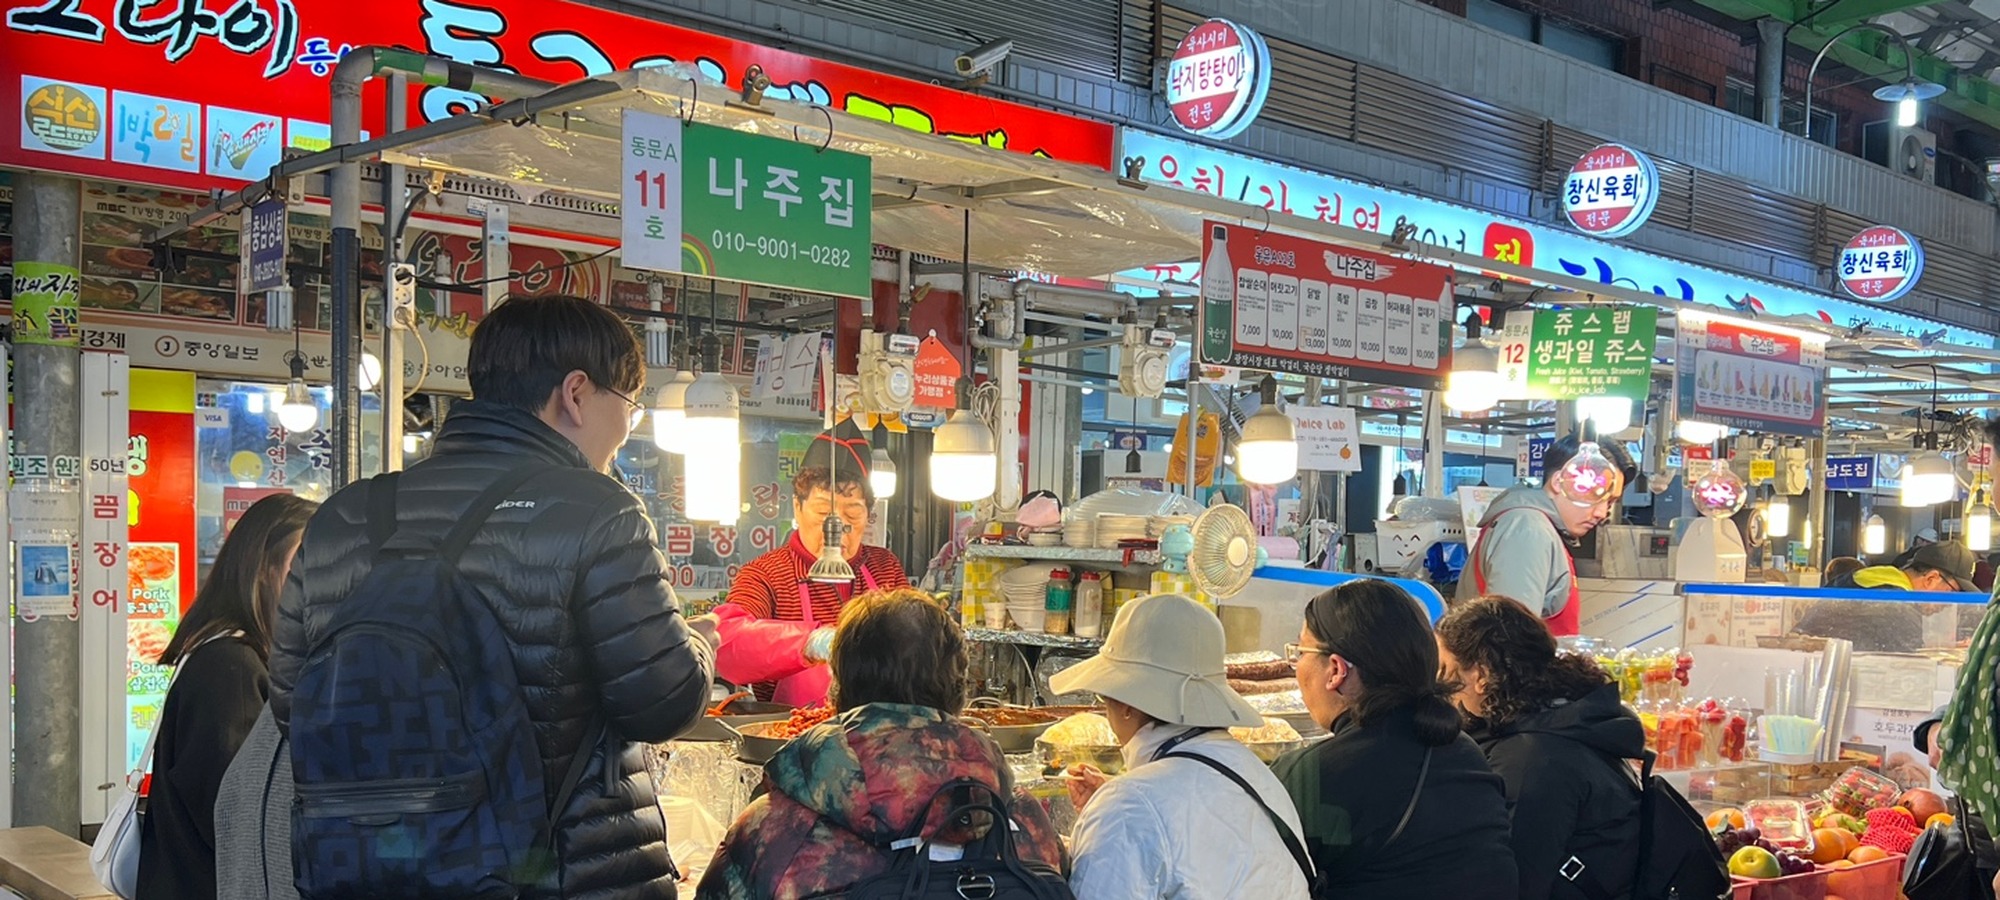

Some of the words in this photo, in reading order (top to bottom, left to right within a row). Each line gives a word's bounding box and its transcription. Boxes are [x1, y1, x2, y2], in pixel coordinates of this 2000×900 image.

[1186, 28, 1227, 52] 육사시미
[1172, 52, 1240, 96] 낙지탕탕이
[1188, 101, 1213, 124] 전문
[66, 132, 94, 142] ROAD
[631, 136, 677, 163] 동문A
[1584, 152, 1625, 171] 육사시미
[634, 169, 667, 210] 11
[709, 157, 853, 228] 나주집
[1567, 173, 1638, 205] 창신육회
[131, 206, 164, 220] TV방영
[1586, 211, 1610, 227] 전문
[252, 208, 284, 253] 충남상회
[644, 215, 665, 240] 호
[712, 230, 850, 268] 010-9001-0282
[1858, 233, 1896, 247] 육사시미
[1337, 255, 1376, 281] 나주집
[1843, 250, 1908, 275] 창신육회
[1860, 280, 1883, 293] 전문
[1242, 324, 1261, 336] 7,000
[1272, 328, 1293, 340] 10,000
[1505, 325, 1529, 337] 동문A
[184, 340, 259, 362] 중앙일보
[1305, 338, 1325, 349] 13,000
[1332, 337, 1352, 348] 10,000
[1361, 341, 1380, 352] 10,000
[1388, 345, 1407, 356] 10,000
[1534, 339, 1595, 365] 생과일
[1603, 339, 1647, 364] 쥬스
[1416, 349, 1435, 359] 10,000
[1505, 343, 1525, 364] 12
[1535, 367, 1551, 375] Fresh
[1610, 366, 1645, 376] Strawberry)
[204, 414, 222, 422] VISA
[267, 425, 288, 487] 자연산
[90, 459, 124, 474] 50년
[667, 525, 776, 556] 꼼장어
[93, 494, 121, 614] 꼼장어
[132, 588, 169, 600] Pork
